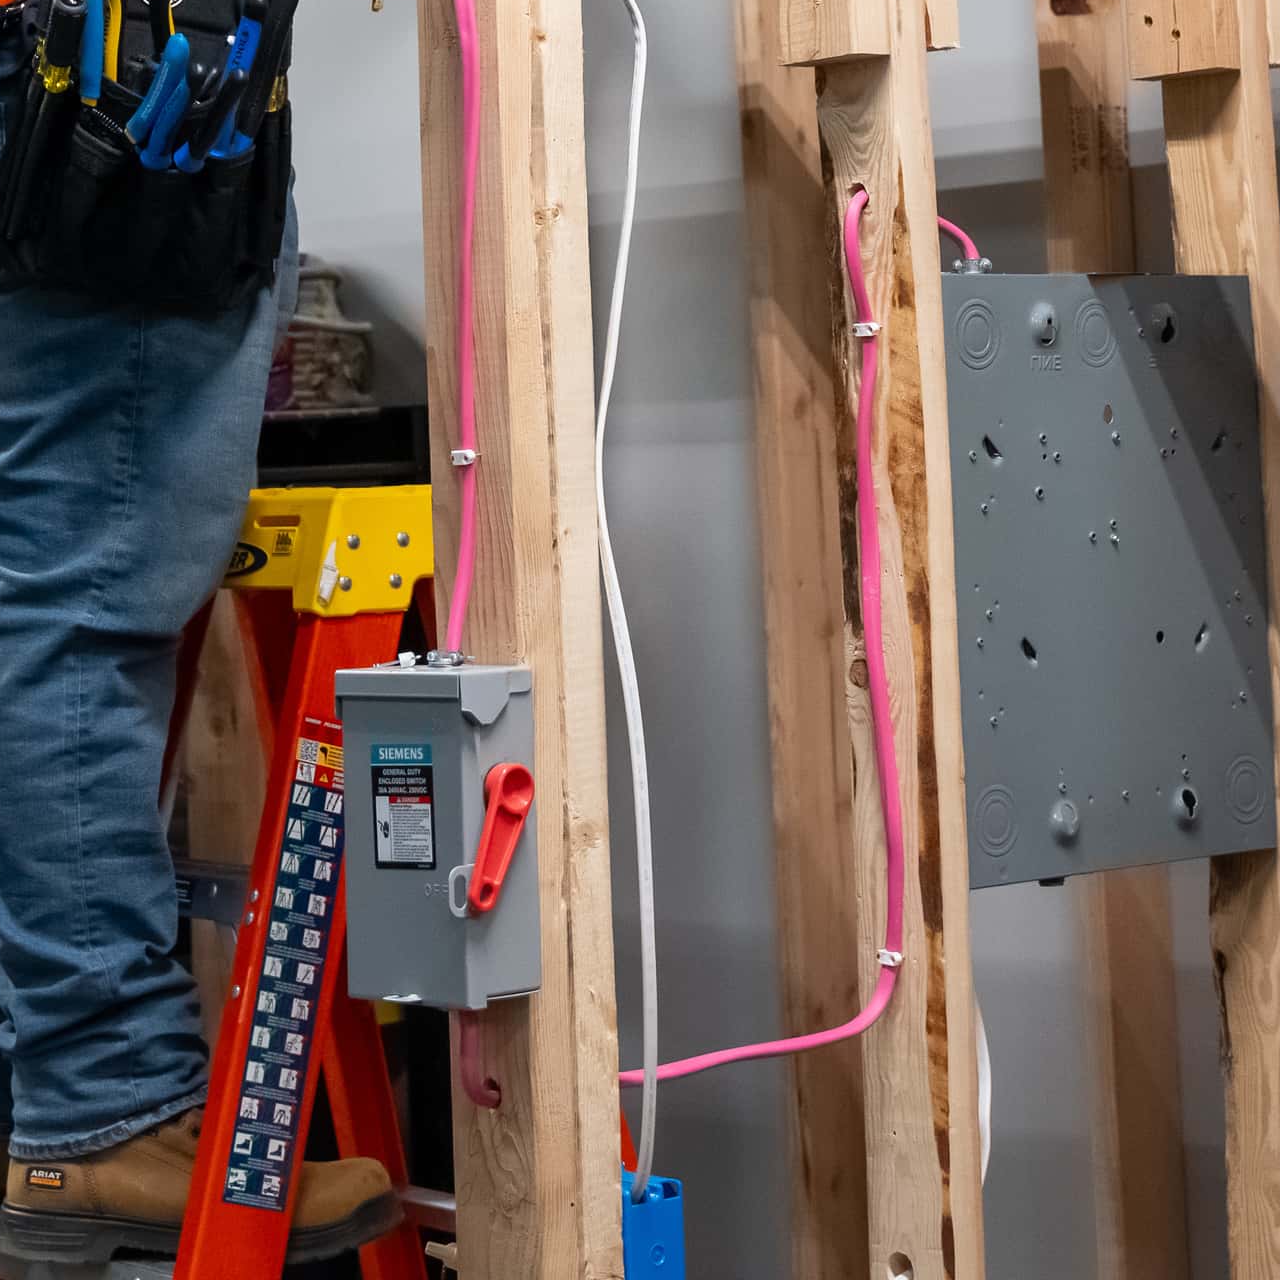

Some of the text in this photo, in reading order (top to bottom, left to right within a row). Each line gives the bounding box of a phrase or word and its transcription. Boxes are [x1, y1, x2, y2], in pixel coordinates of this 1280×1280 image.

[378, 747, 424, 760] SIEMENS
[382, 768, 421, 776] GENERAL DUTY
[378, 777, 426, 785] ENCLOSED SWITCH
[31, 1170, 62, 1180] ARIAT
